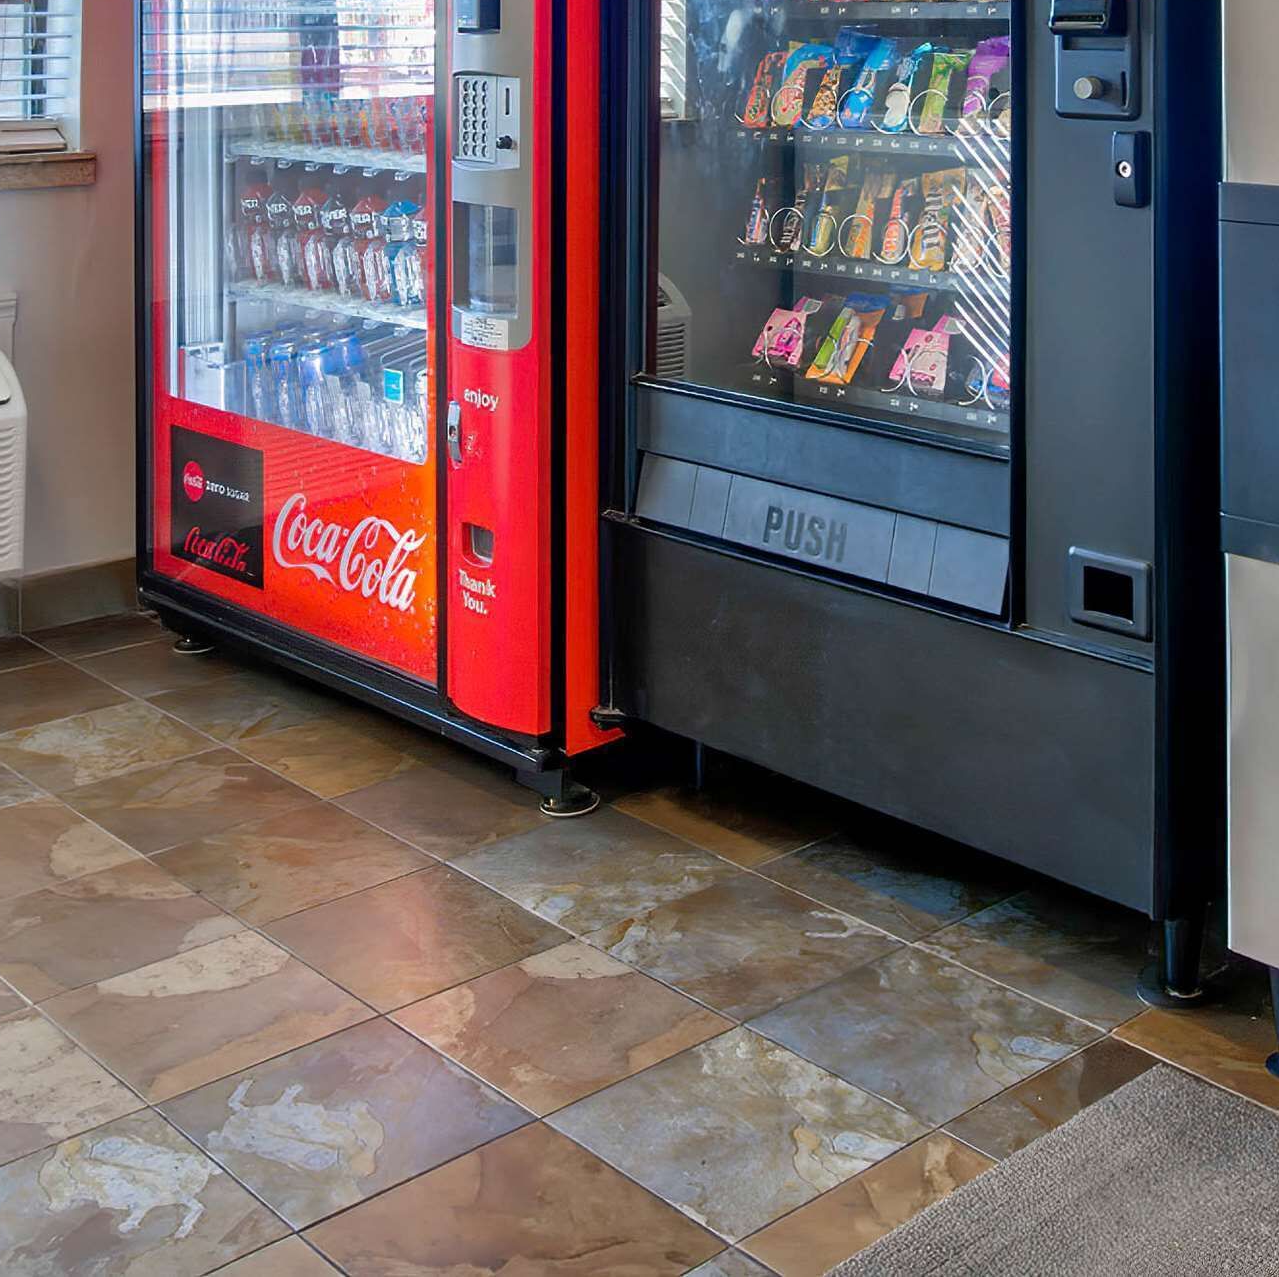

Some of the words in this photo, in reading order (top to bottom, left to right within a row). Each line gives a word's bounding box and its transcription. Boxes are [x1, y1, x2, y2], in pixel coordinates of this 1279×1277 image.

[463, 388, 499, 412] enjoy
[763, 505, 848, 563] PUSH
[272, 492, 428, 612] Coca-Cola
[458, 568, 497, 598] Thank
[462, 590, 489, 615] You.
